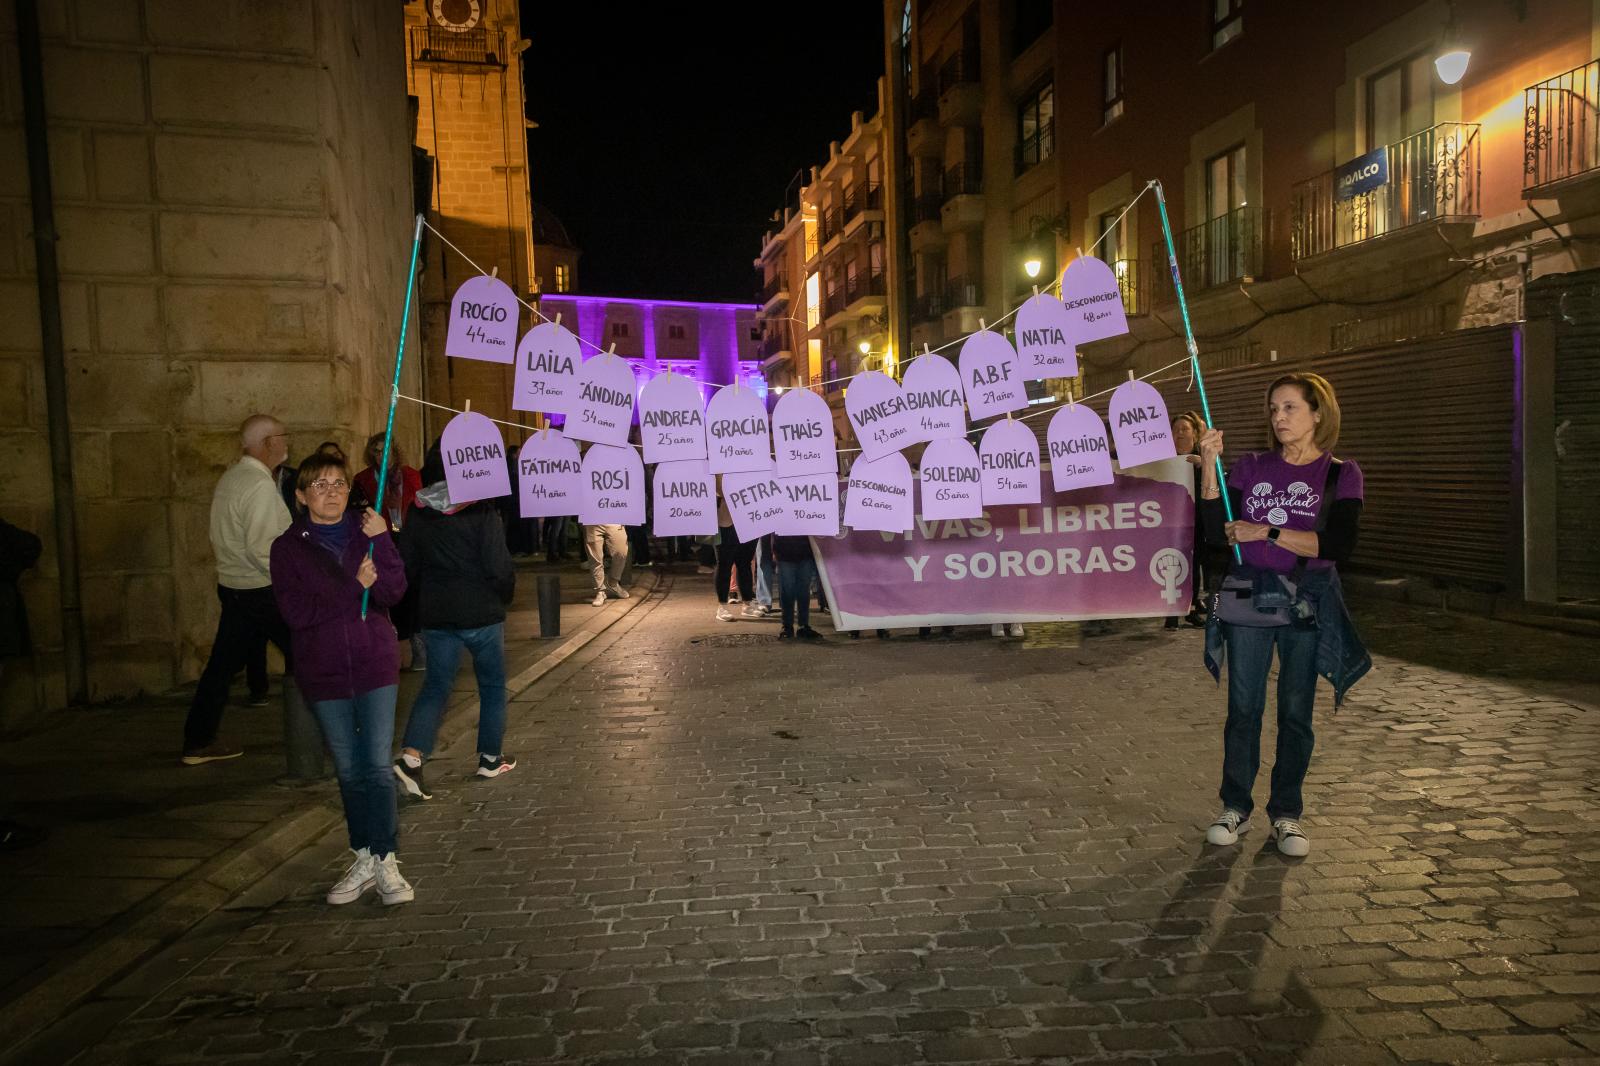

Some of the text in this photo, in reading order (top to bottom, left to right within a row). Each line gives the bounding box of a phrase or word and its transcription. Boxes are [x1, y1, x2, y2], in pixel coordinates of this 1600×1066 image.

[1064, 291, 1118, 311] DESCONOCIDA
[460, 301, 507, 322] ROCÍO
[1083, 312, 1096, 322] 48
[466, 325, 506, 346] 44 años
[1022, 327, 1066, 347] NATIA
[527, 349, 574, 375] LAILA
[1033, 354, 1064, 366] 32 años
[972, 361, 1012, 388] A.B.F
[528, 381, 563, 396] 37 años
[906, 389, 962, 411] BIANCA
[983, 391, 1014, 404] 29 años
[581, 409, 615, 428] 54 años
[643, 410, 702, 427] ANDREA
[853, 396, 908, 427] VANESA
[1119, 408, 1148, 428] ANA
[711, 416, 766, 439] GRACIA
[779, 419, 823, 441] THAIS
[920, 416, 950, 430] 44 años
[657, 433, 672, 445] 25
[873, 427, 907, 444] 43 años
[1131, 431, 1167, 446] 57 años
[447, 443, 502, 466] LORENA
[720, 446, 753, 457] 49 años
[1050, 434, 1107, 458] RACHIDA
[789, 450, 802, 460] 34
[981, 449, 1035, 470] FLORICA
[462, 469, 491, 480] 46 años
[521, 458, 571, 476] FÁTIMA
[923, 467, 980, 483] SOLEDAD
[1066, 465, 1094, 476] 51 años
[591, 468, 629, 490] ROSI
[997, 477, 1011, 490] 54
[532, 484, 567, 499] 44 años
[661, 482, 708, 498] LAURA
[729, 480, 782, 509] PETRA
[849, 479, 907, 497] DESCONOCIDA
[935, 488, 969, 500] 65 años
[598, 498, 628, 508] 67 años
[861, 497, 892, 510] 62 años
[1247, 491, 1319, 513] Sororidad
[670, 507, 702, 517] 20 años
[748, 507, 784, 523] 76 años
[793, 509, 826, 519] 30 años
[1019, 500, 1163, 535] LIBRES
[904, 545, 1136, 581] Y SORORAS
